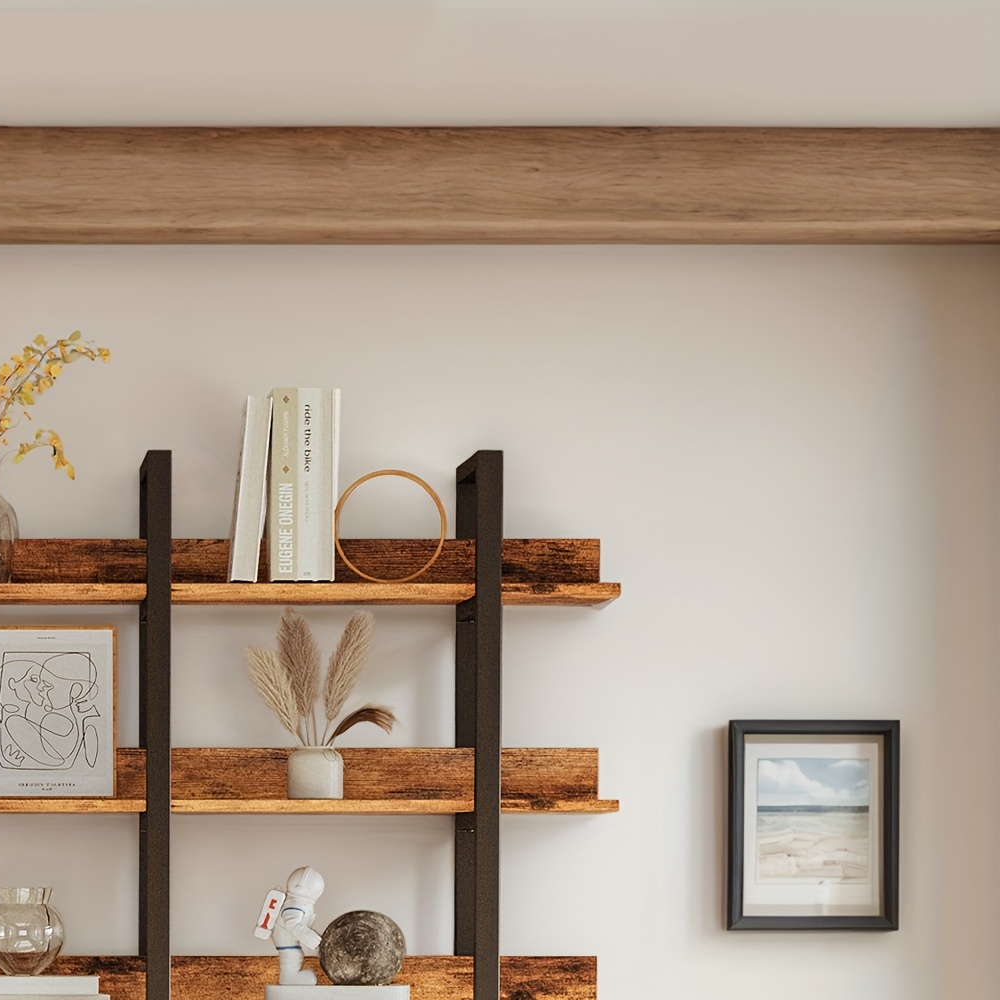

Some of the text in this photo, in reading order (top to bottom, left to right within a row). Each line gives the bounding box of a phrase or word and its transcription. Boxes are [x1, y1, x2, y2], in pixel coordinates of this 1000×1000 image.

[304, 404, 312, 473] ride the bike
[278, 483, 293, 573] EUGENE ONEGIN
